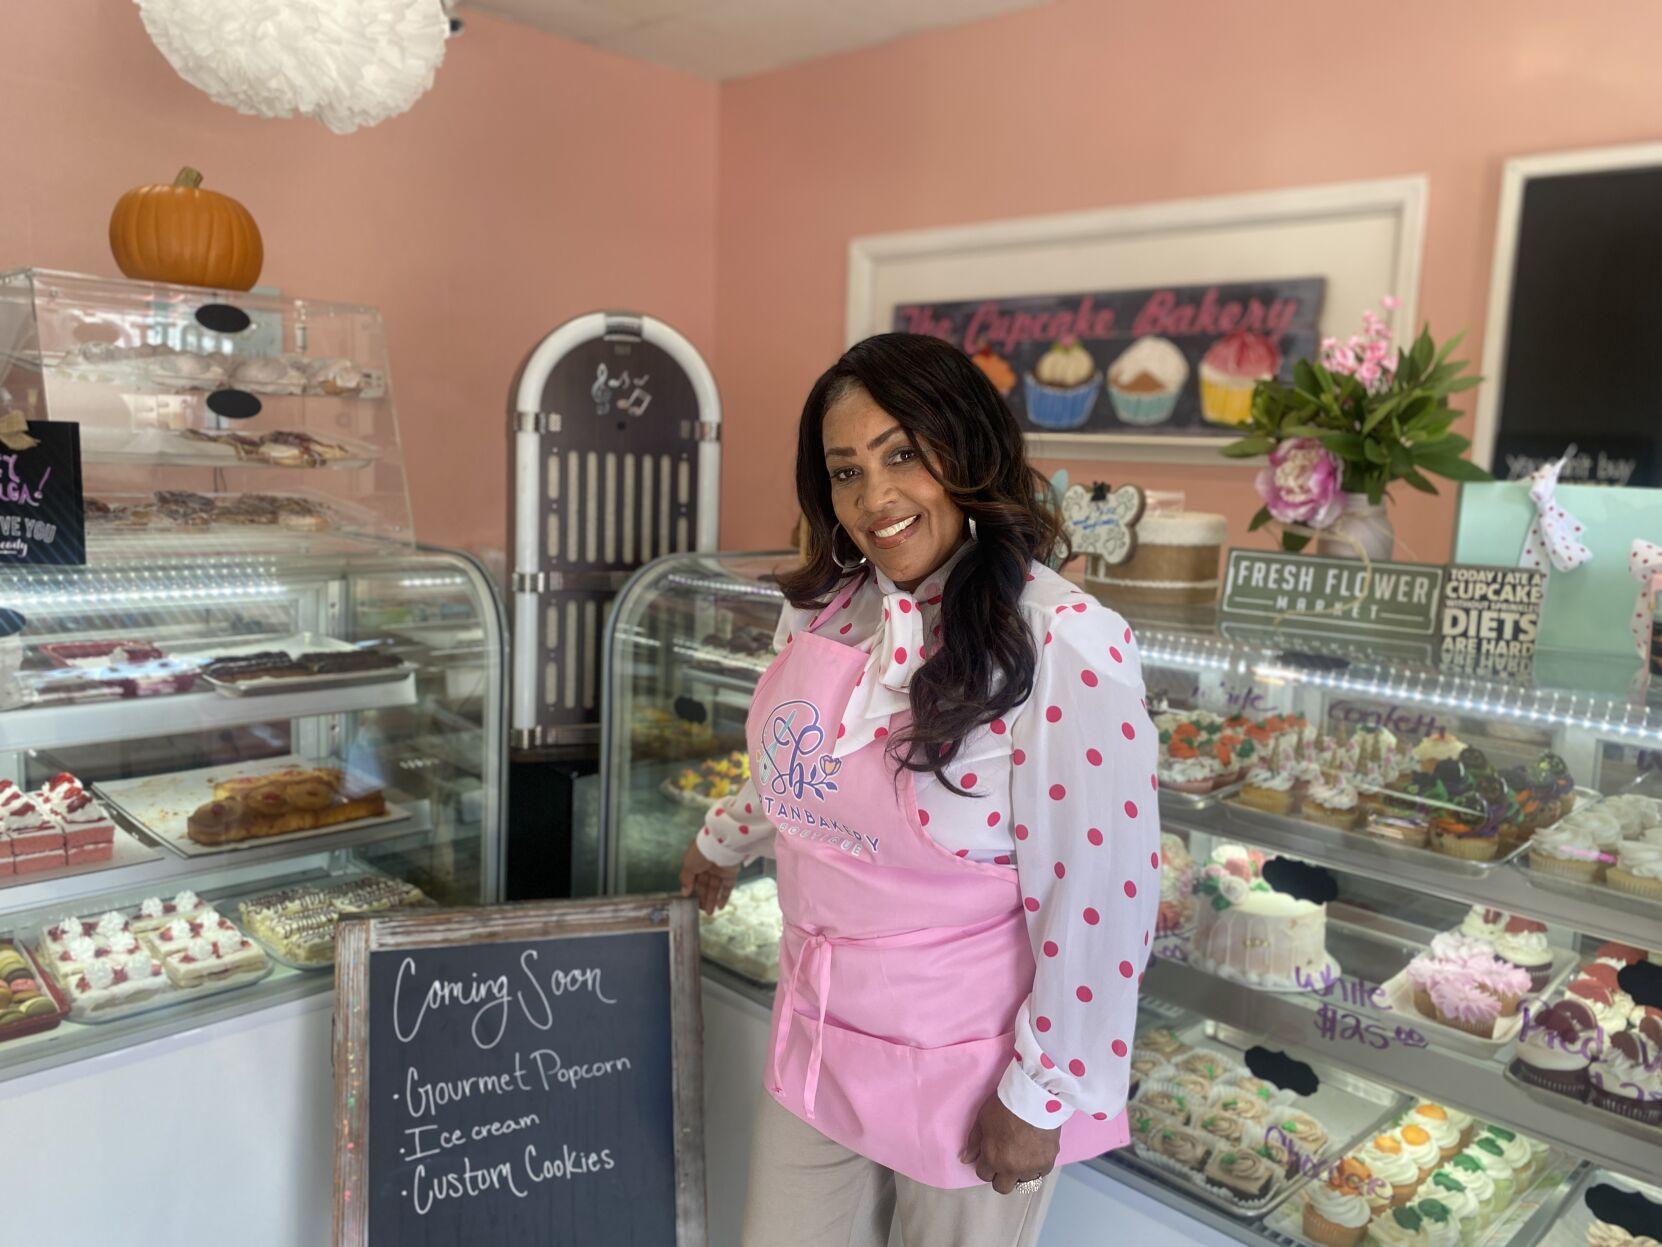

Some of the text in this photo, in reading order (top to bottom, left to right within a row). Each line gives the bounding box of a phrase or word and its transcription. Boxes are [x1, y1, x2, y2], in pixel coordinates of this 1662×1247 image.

[963, 295, 1116, 355] Cupcake
[1131, 286, 1299, 343] Bakery
[24, 517, 57, 544] YOU
[1237, 560, 1430, 605] FRESH FLOWER
[1445, 580, 1544, 603] CUPCAKE
[1450, 569, 1495, 583] TODAY
[1504, 572, 1530, 585] ATE
[1275, 595, 1380, 619] MARKET
[1442, 607, 1538, 642] DIETS
[1441, 636, 1535, 657] ARE HARD
[393, 949, 617, 1049] Coming Soon
[406, 1049, 631, 1117] Gourmet Popcorn
[404, 1112, 540, 1161] Ice cream
[413, 1144, 616, 1214] Custom Cookies
